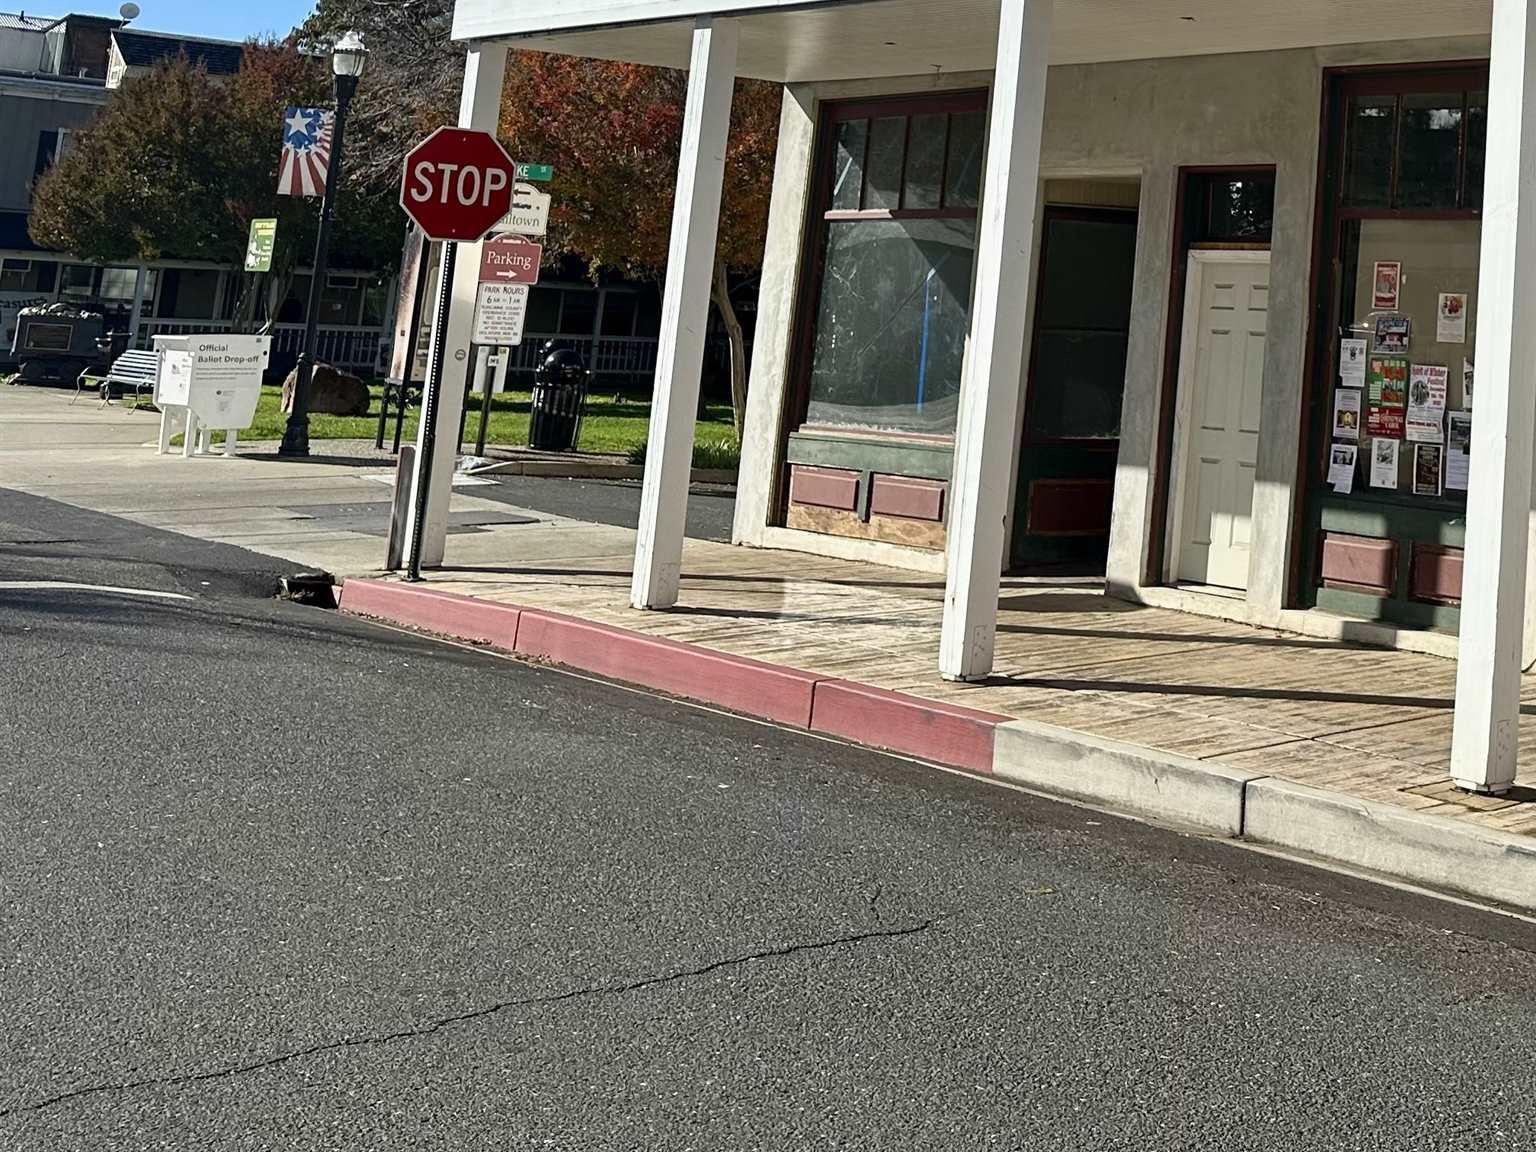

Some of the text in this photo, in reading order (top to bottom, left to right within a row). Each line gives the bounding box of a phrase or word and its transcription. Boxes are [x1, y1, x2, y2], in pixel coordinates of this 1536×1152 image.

[410, 161, 507, 207] STOP
[486, 251, 532, 270] Parking
[199, 344, 229, 352] Official
[197, 355, 260, 364] Ballot Drop-off
